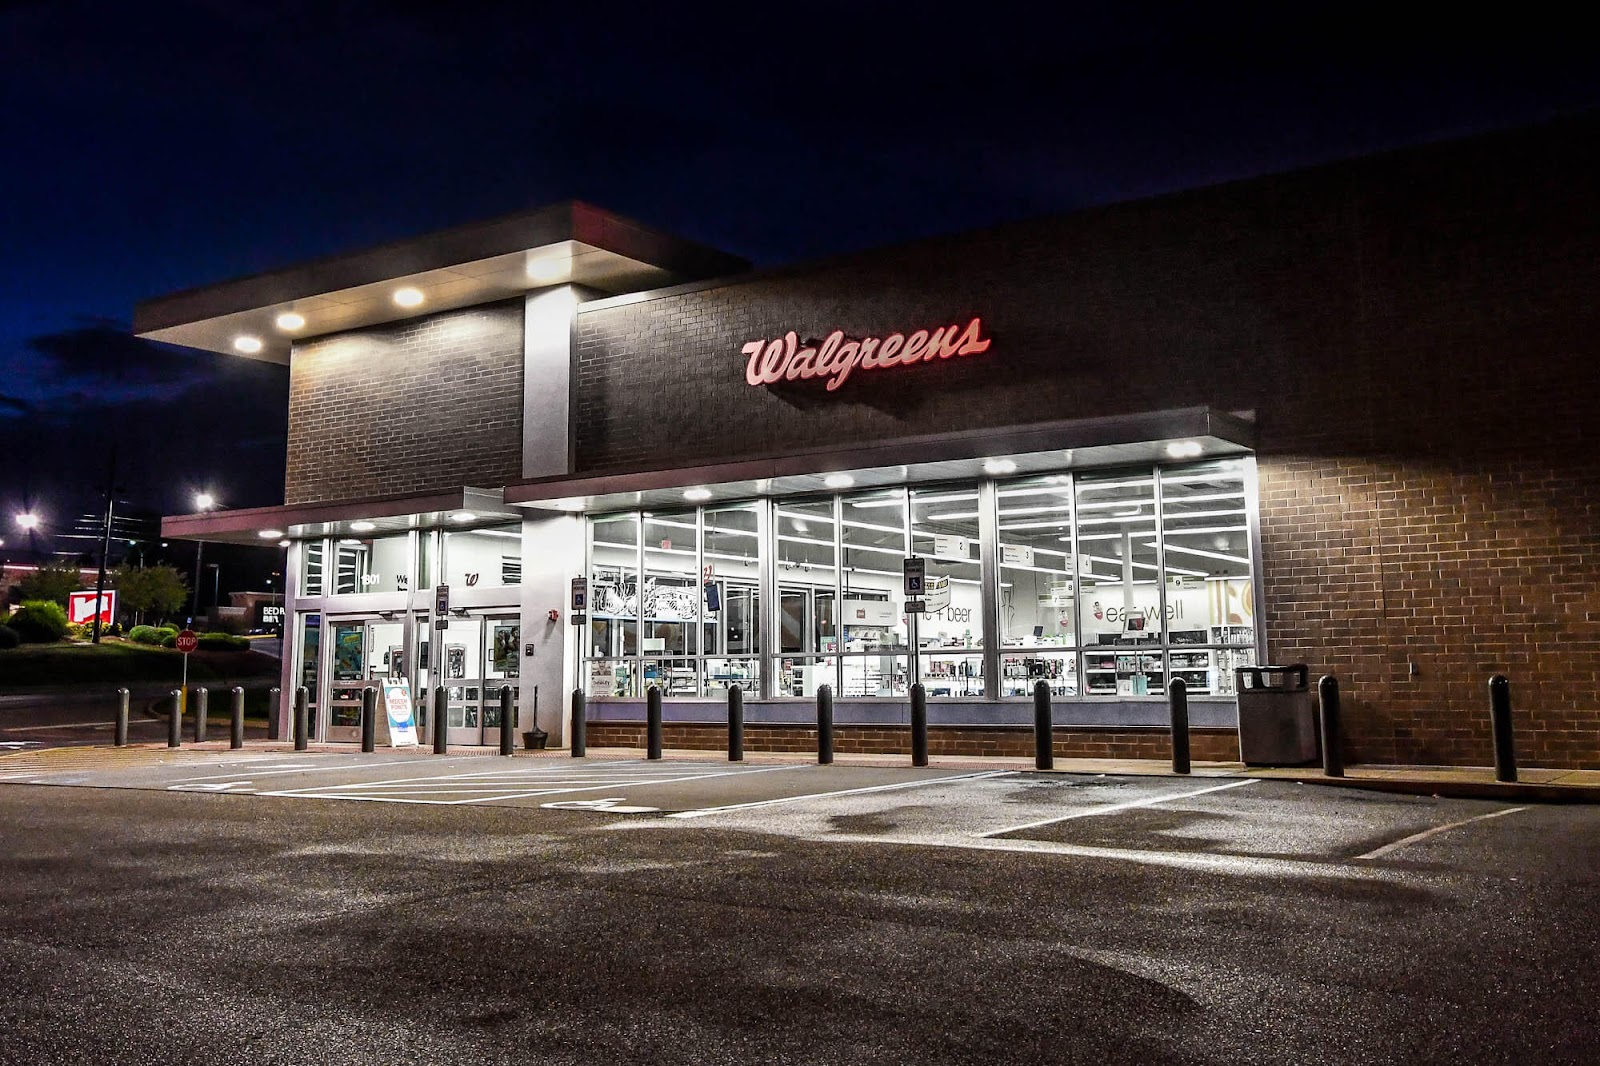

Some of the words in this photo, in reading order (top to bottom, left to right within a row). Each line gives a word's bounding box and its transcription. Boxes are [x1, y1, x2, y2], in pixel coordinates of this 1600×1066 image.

[741, 317, 992, 391] Walgreens
[947, 605, 972, 622] beer
[1143, 599, 1184, 620] well
[177, 636, 196, 646] STOP
